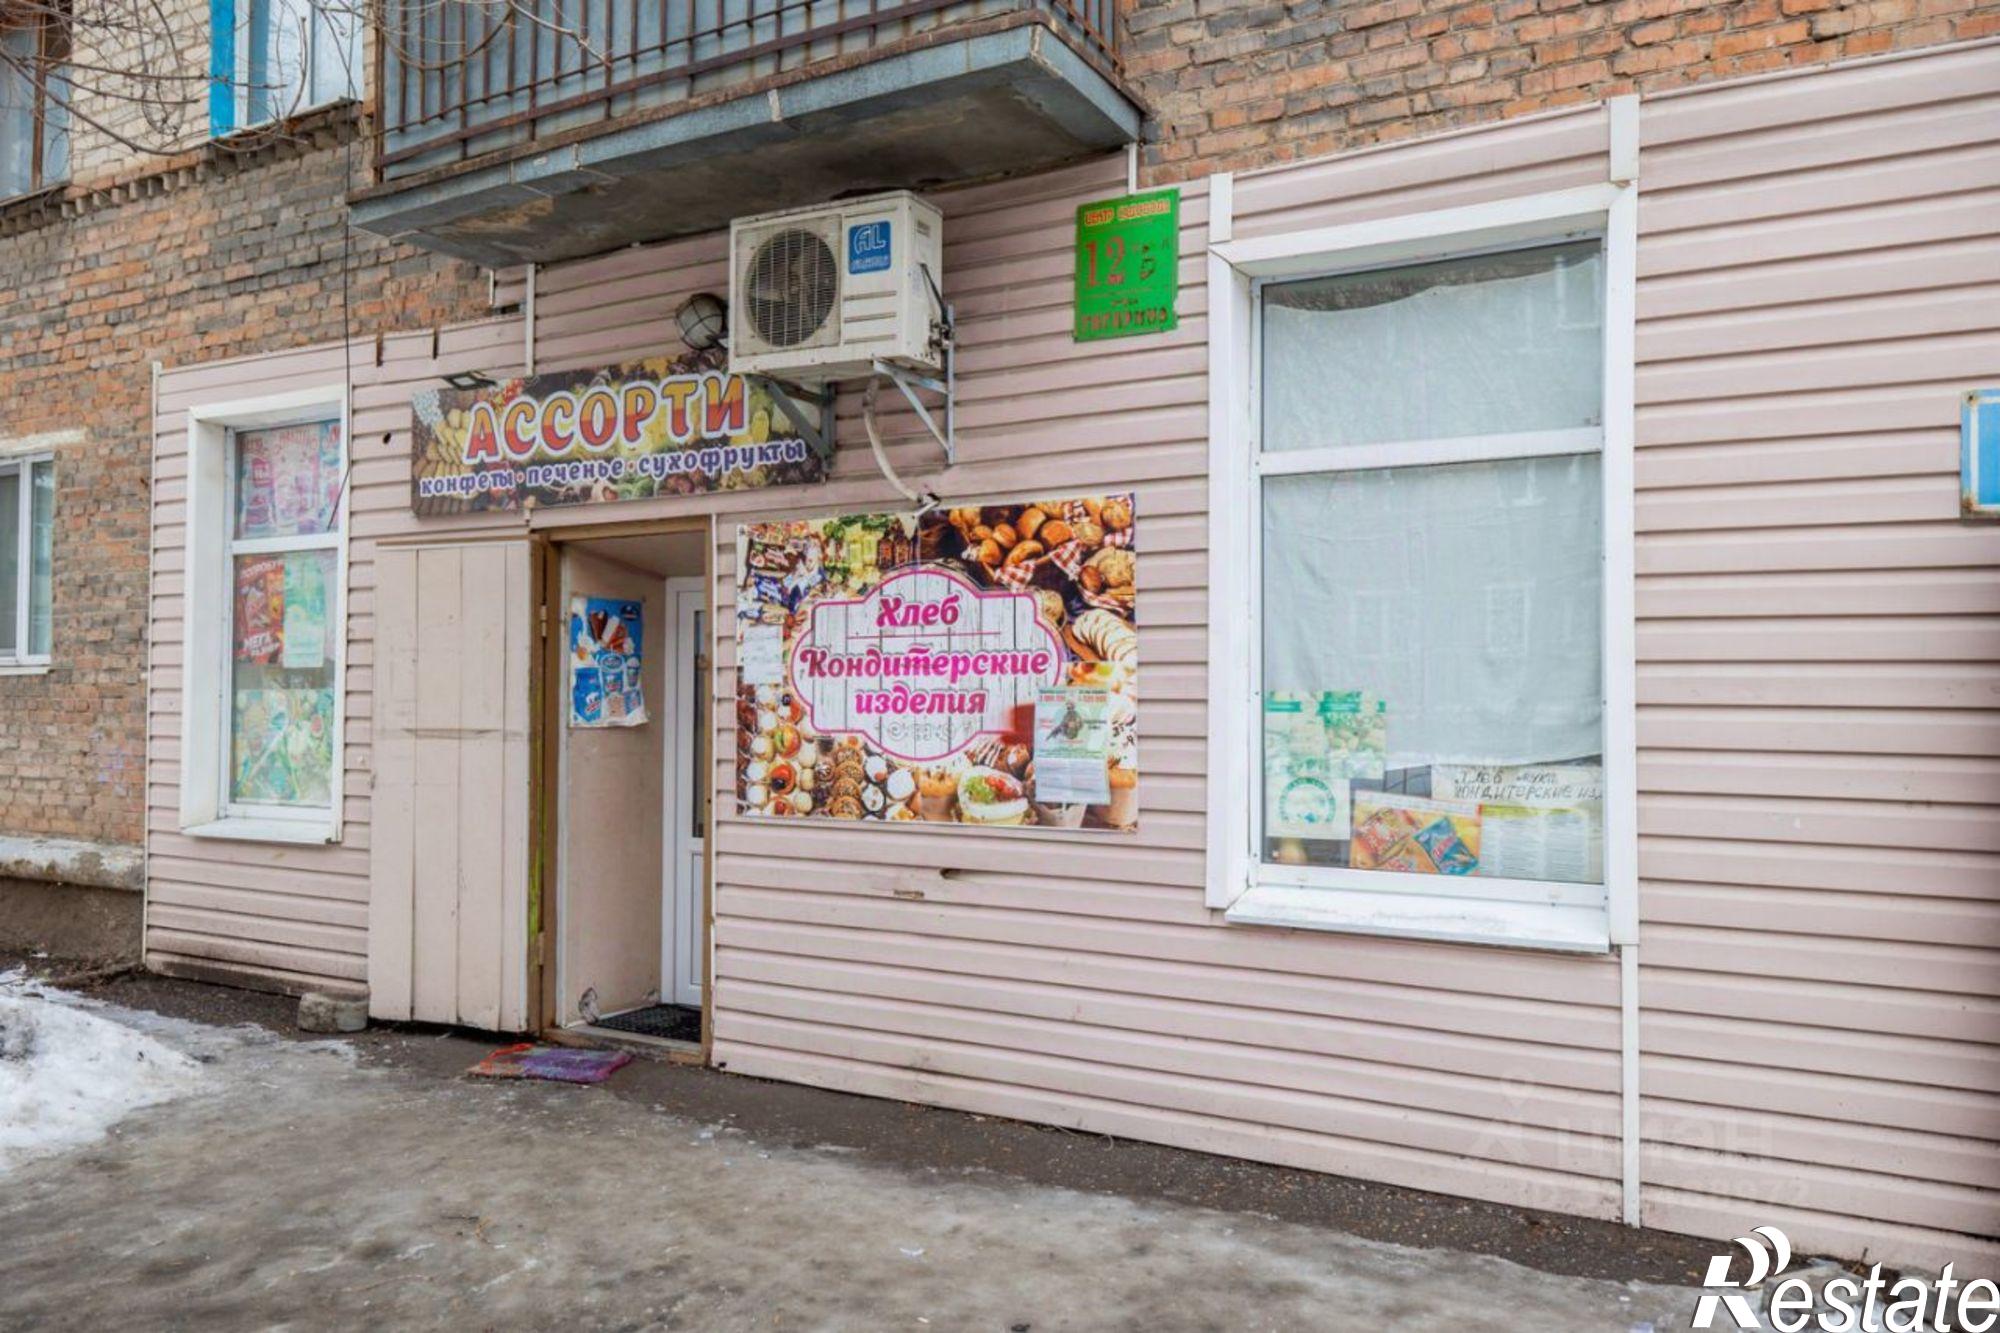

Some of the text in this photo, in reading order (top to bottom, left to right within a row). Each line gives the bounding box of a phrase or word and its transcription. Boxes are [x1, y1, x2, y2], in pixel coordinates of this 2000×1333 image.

[464, 372, 748, 462] АССОРТИ
[420, 439, 806, 497] конфеты печенье сухофрукты
[876, 594, 960, 628] Хлеб
[800, 646, 1050, 684] Кондитерские
[855, 682, 989, 715] изделия
